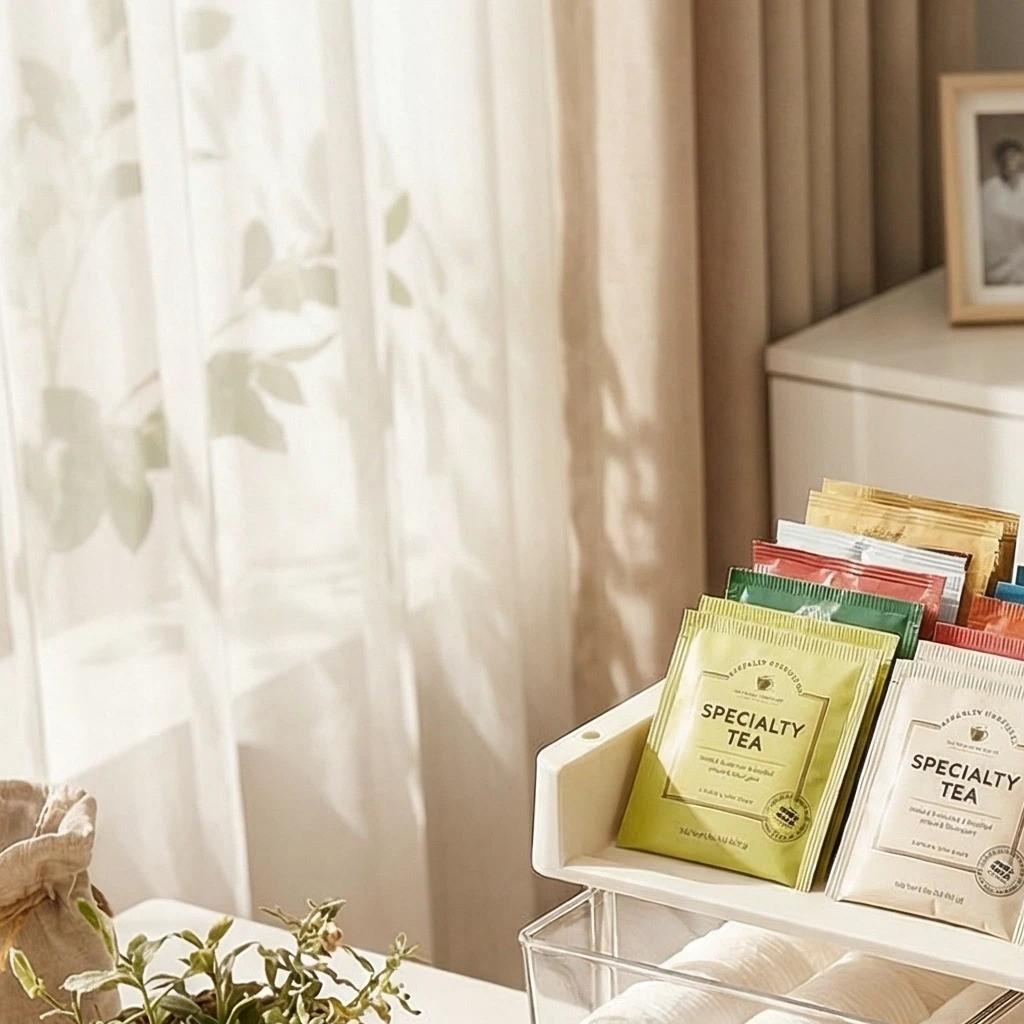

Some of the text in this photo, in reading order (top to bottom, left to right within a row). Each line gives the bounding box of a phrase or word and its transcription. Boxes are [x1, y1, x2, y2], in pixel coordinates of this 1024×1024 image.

[701, 704, 806, 739] SPECIALTY
[727, 729, 762, 752] TEA
[911, 754, 1022, 792] SPECIALTY
[941, 781, 978, 806] TEA
